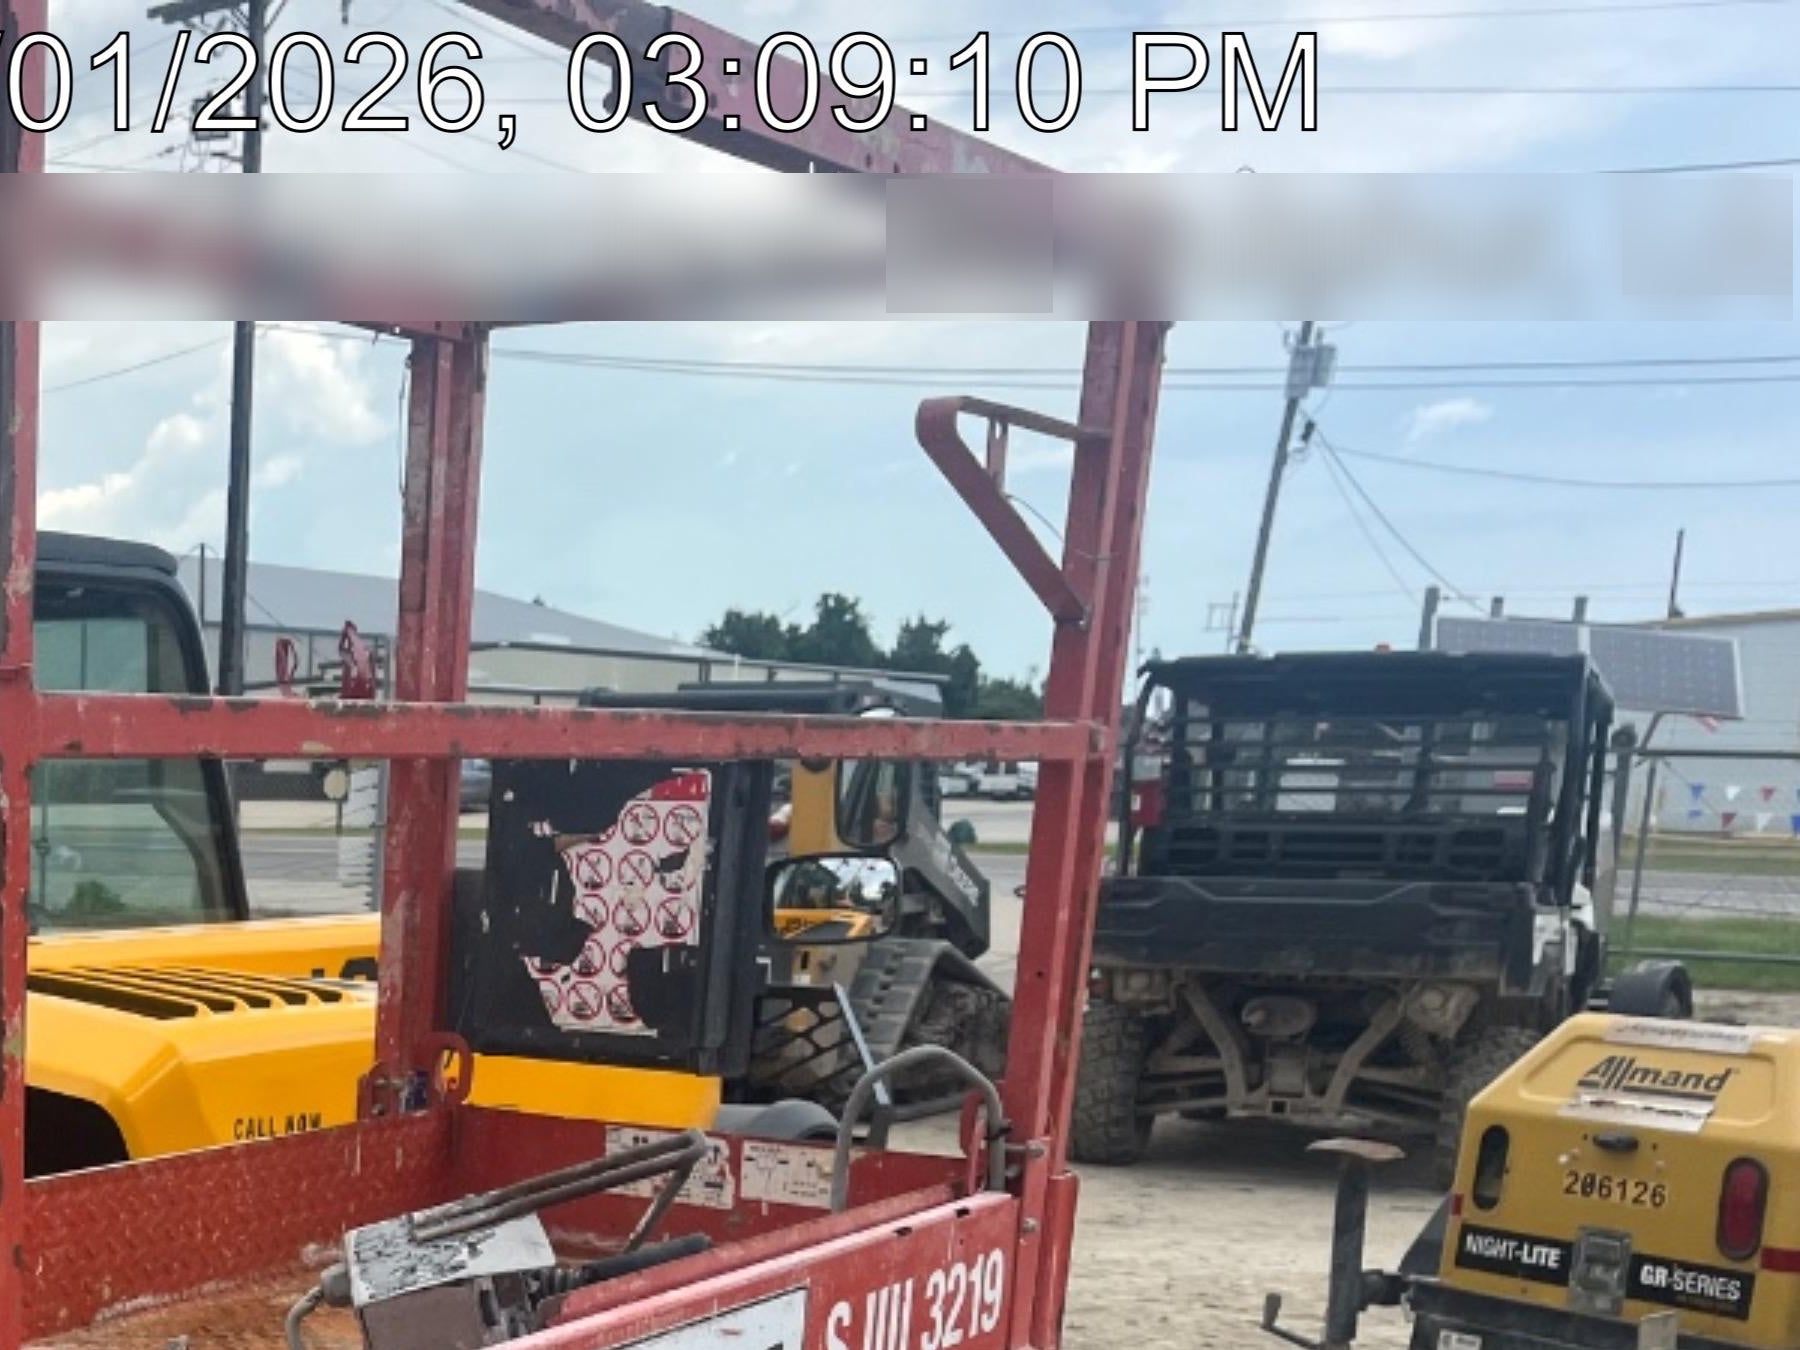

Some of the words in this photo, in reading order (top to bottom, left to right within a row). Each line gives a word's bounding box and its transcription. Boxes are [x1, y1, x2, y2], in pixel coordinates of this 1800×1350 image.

[1582, 1055, 1733, 1092] Allmand
[234, 1117, 276, 1140] CALL
[1465, 1232, 1562, 1269] NIGHT-LITE
